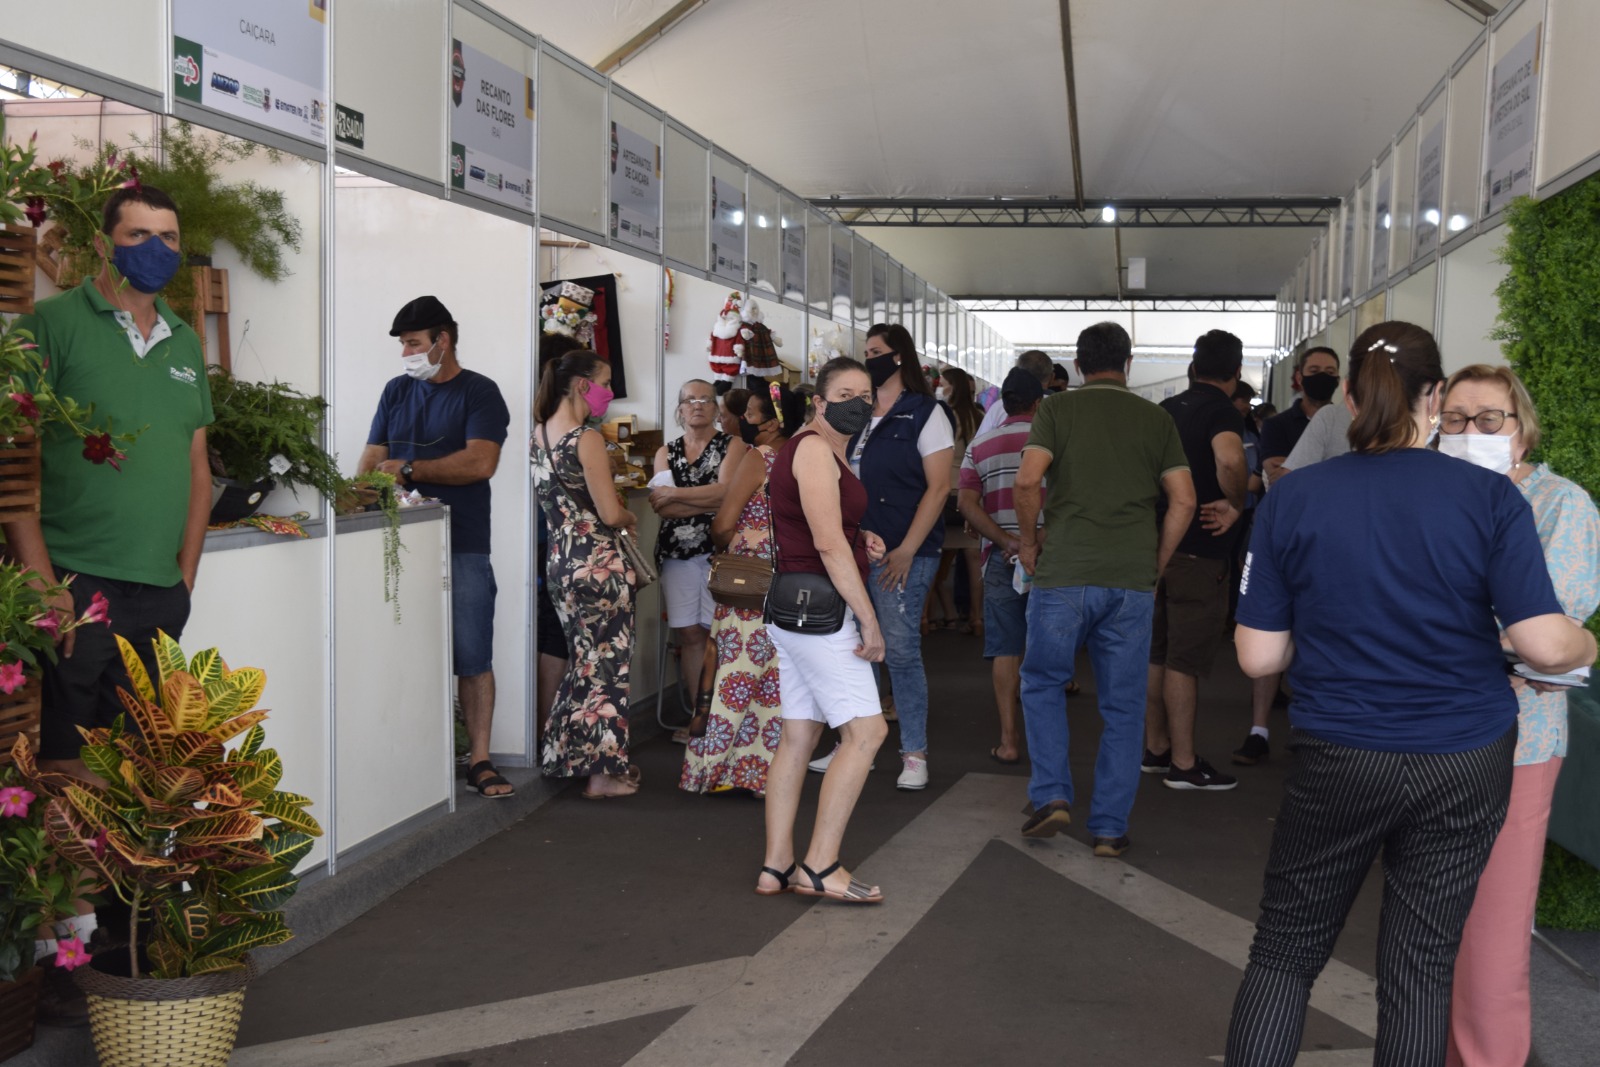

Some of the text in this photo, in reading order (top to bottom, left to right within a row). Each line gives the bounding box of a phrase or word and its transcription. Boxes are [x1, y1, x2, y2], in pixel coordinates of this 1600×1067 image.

[240, 19, 276, 46] CAIÇARA
[481, 80, 511, 106] RECANTO
[476, 98, 515, 128] DAS FLORES
[346, 115, 364, 142] SAÍDA
